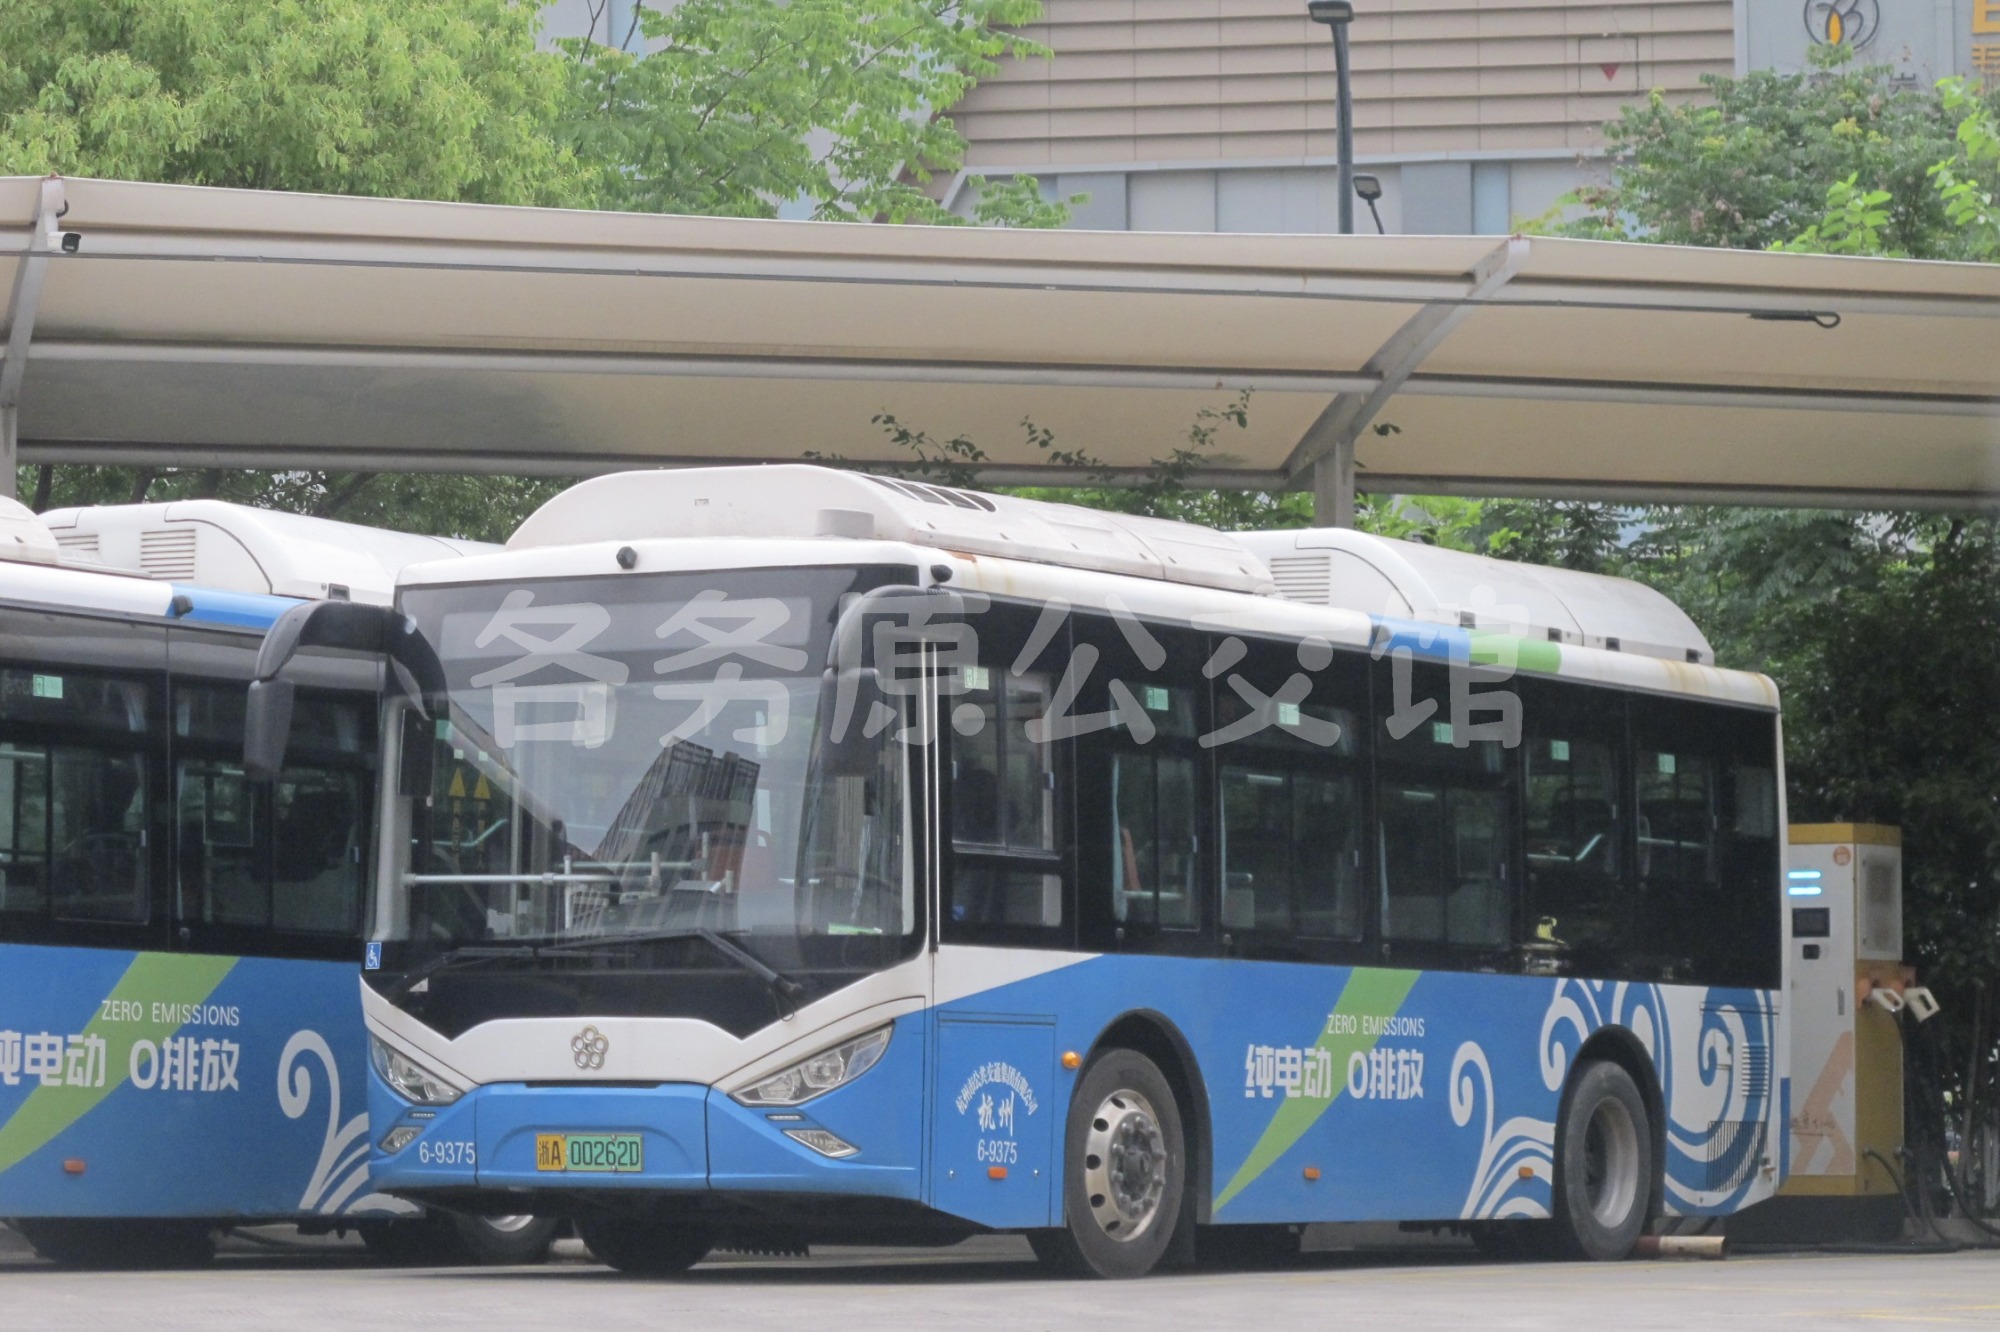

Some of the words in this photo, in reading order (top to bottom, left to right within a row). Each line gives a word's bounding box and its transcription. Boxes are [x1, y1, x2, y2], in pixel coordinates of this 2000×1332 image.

[101, 1000, 142, 1021] ZERO
[152, 1003, 239, 1026] EMISSIONS
[1327, 1014, 1356, 1034] ZERO
[1363, 1017, 1425, 1037] EMISSIONS
[1245, 1044, 1331, 1098] 纯电动
[978, 1091, 1014, 1136] 杭州
[419, 1141, 476, 1164] 6-9375
[978, 1139, 1017, 1164] 6-9375
